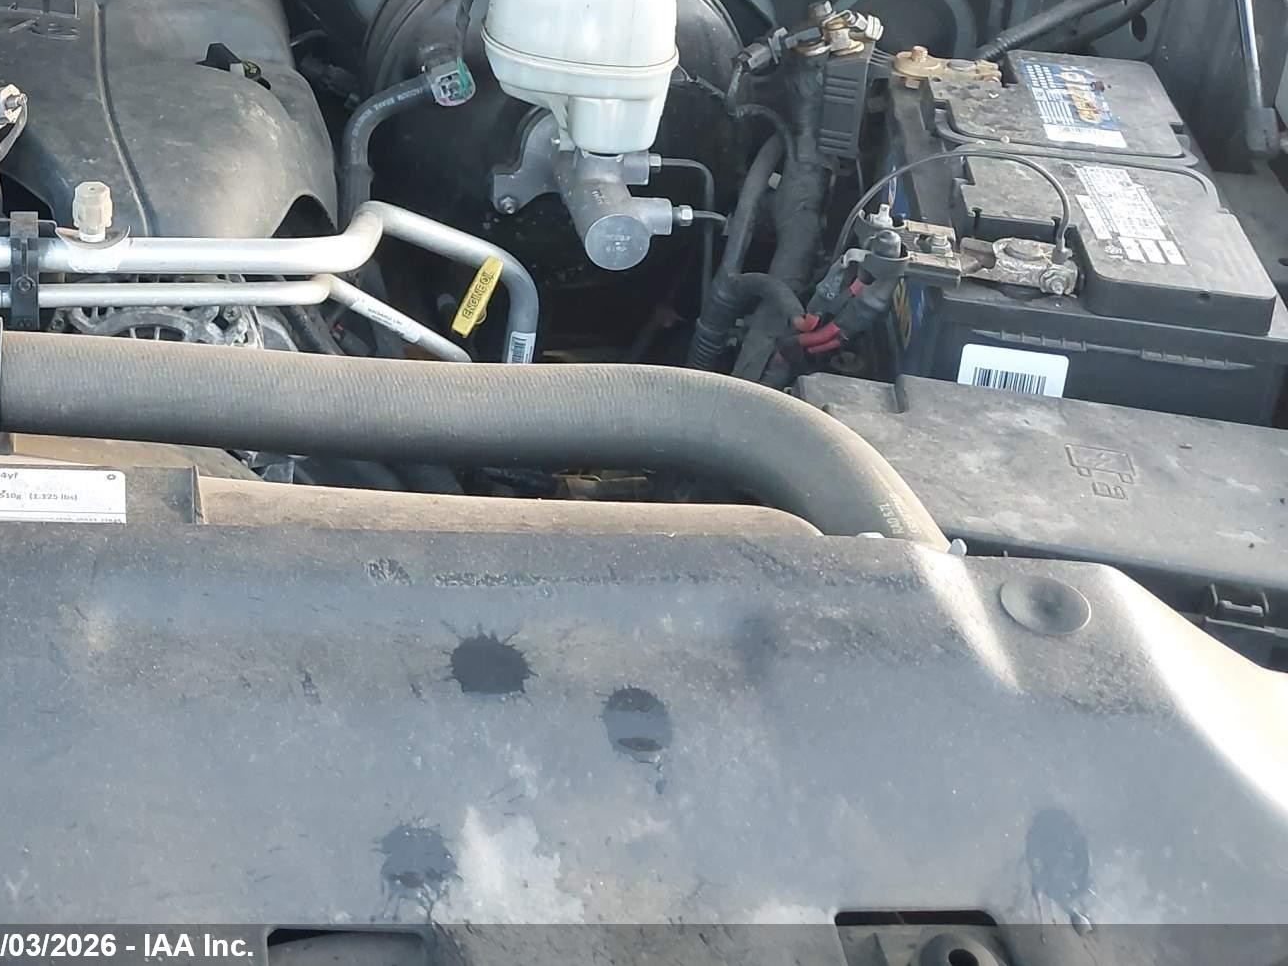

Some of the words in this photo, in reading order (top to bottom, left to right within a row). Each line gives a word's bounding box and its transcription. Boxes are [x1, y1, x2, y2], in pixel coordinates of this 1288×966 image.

[462, 283, 485, 319] ENGINE
[480, 271, 495, 285] OIL
[60, 492, 78, 502] lbs)
